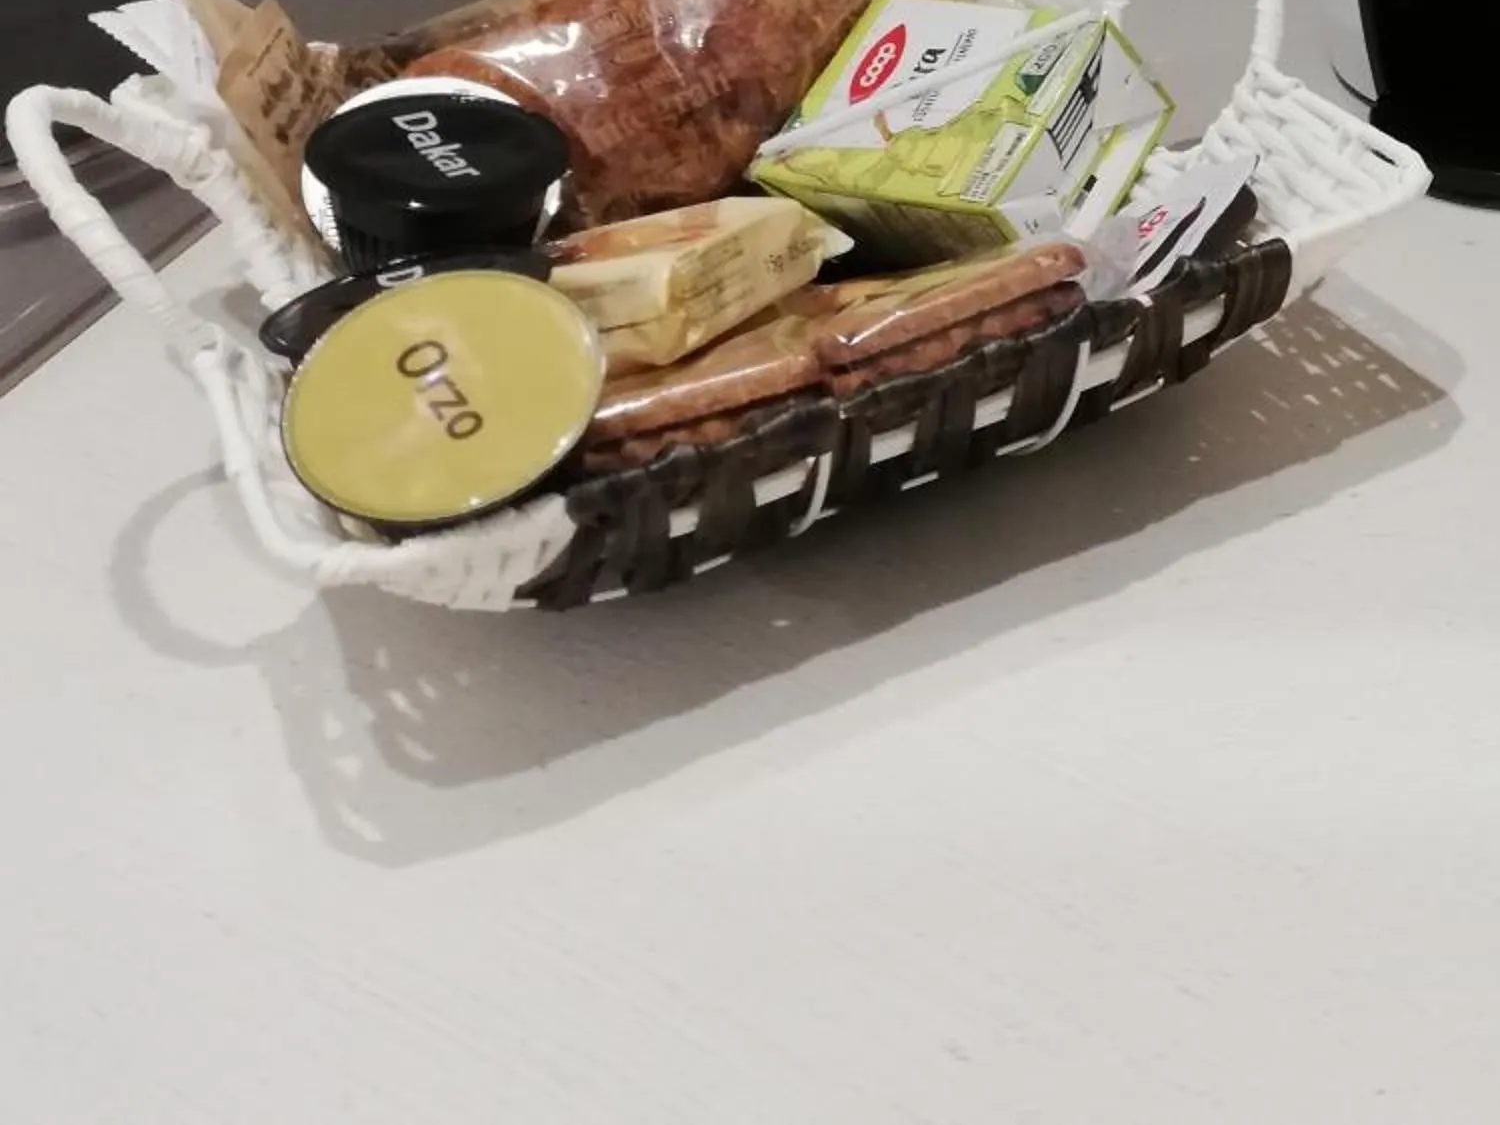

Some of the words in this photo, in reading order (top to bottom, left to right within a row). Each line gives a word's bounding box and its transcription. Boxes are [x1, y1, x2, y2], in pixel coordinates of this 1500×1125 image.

[858, 41, 898, 88] coop
[392, 110, 481, 179] Dakar
[396, 339, 484, 441] Orzo
